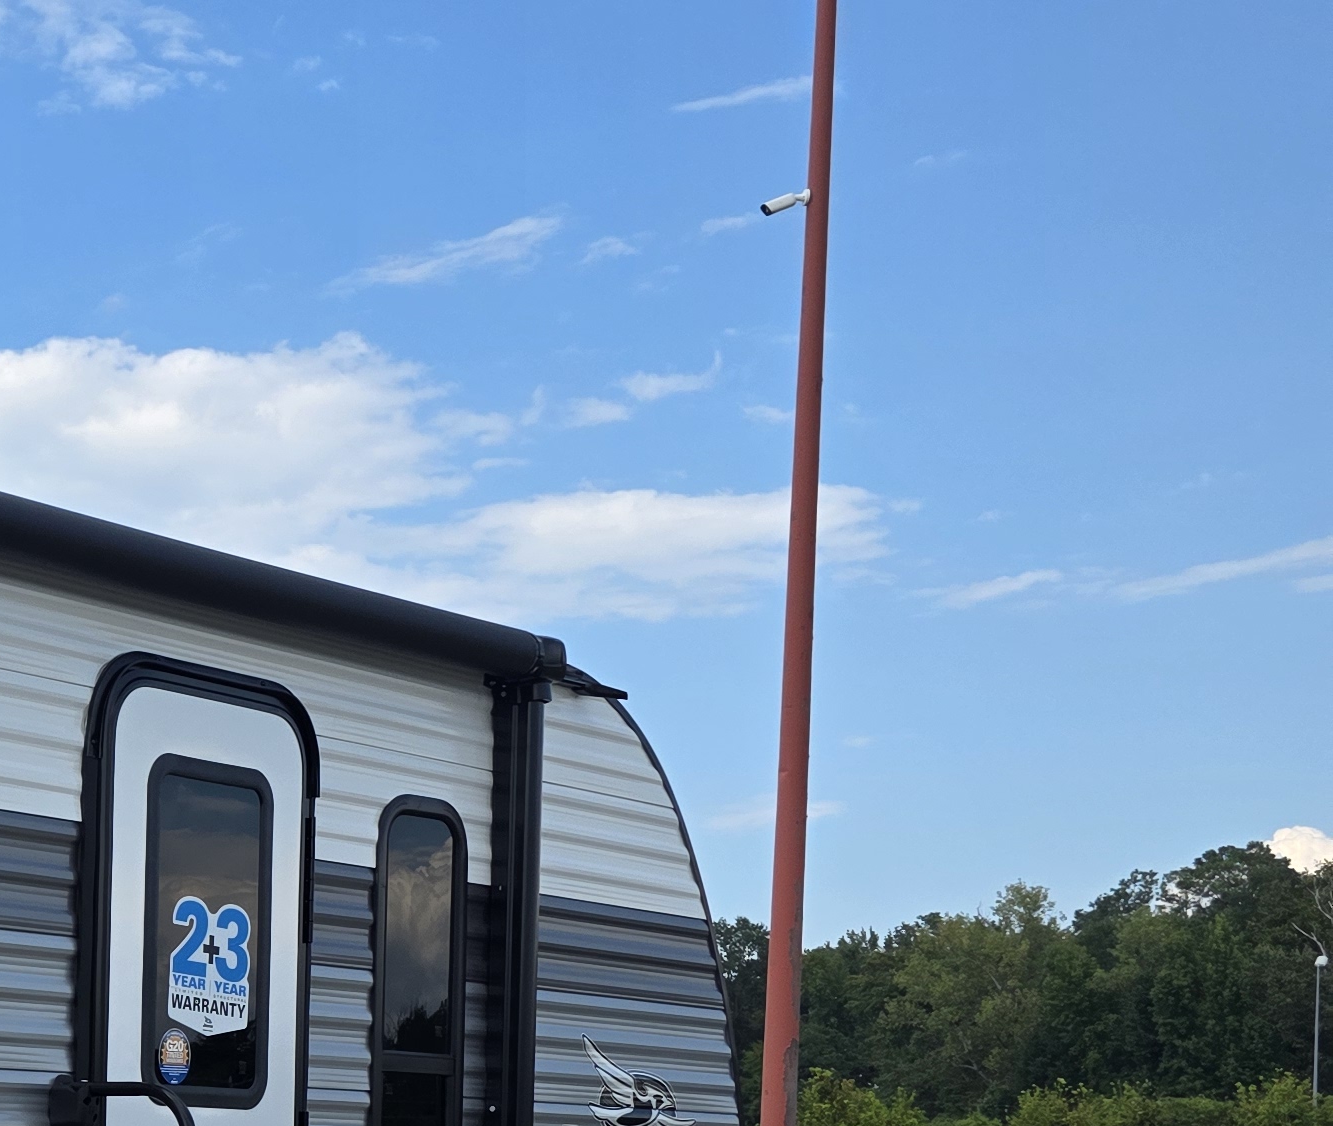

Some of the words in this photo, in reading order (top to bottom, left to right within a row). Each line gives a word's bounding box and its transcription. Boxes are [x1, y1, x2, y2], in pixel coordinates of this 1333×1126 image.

[173, 974, 206, 990] YEAR
[214, 981, 247, 997] YEAR
[171, 993, 246, 1019] WARRANTY
